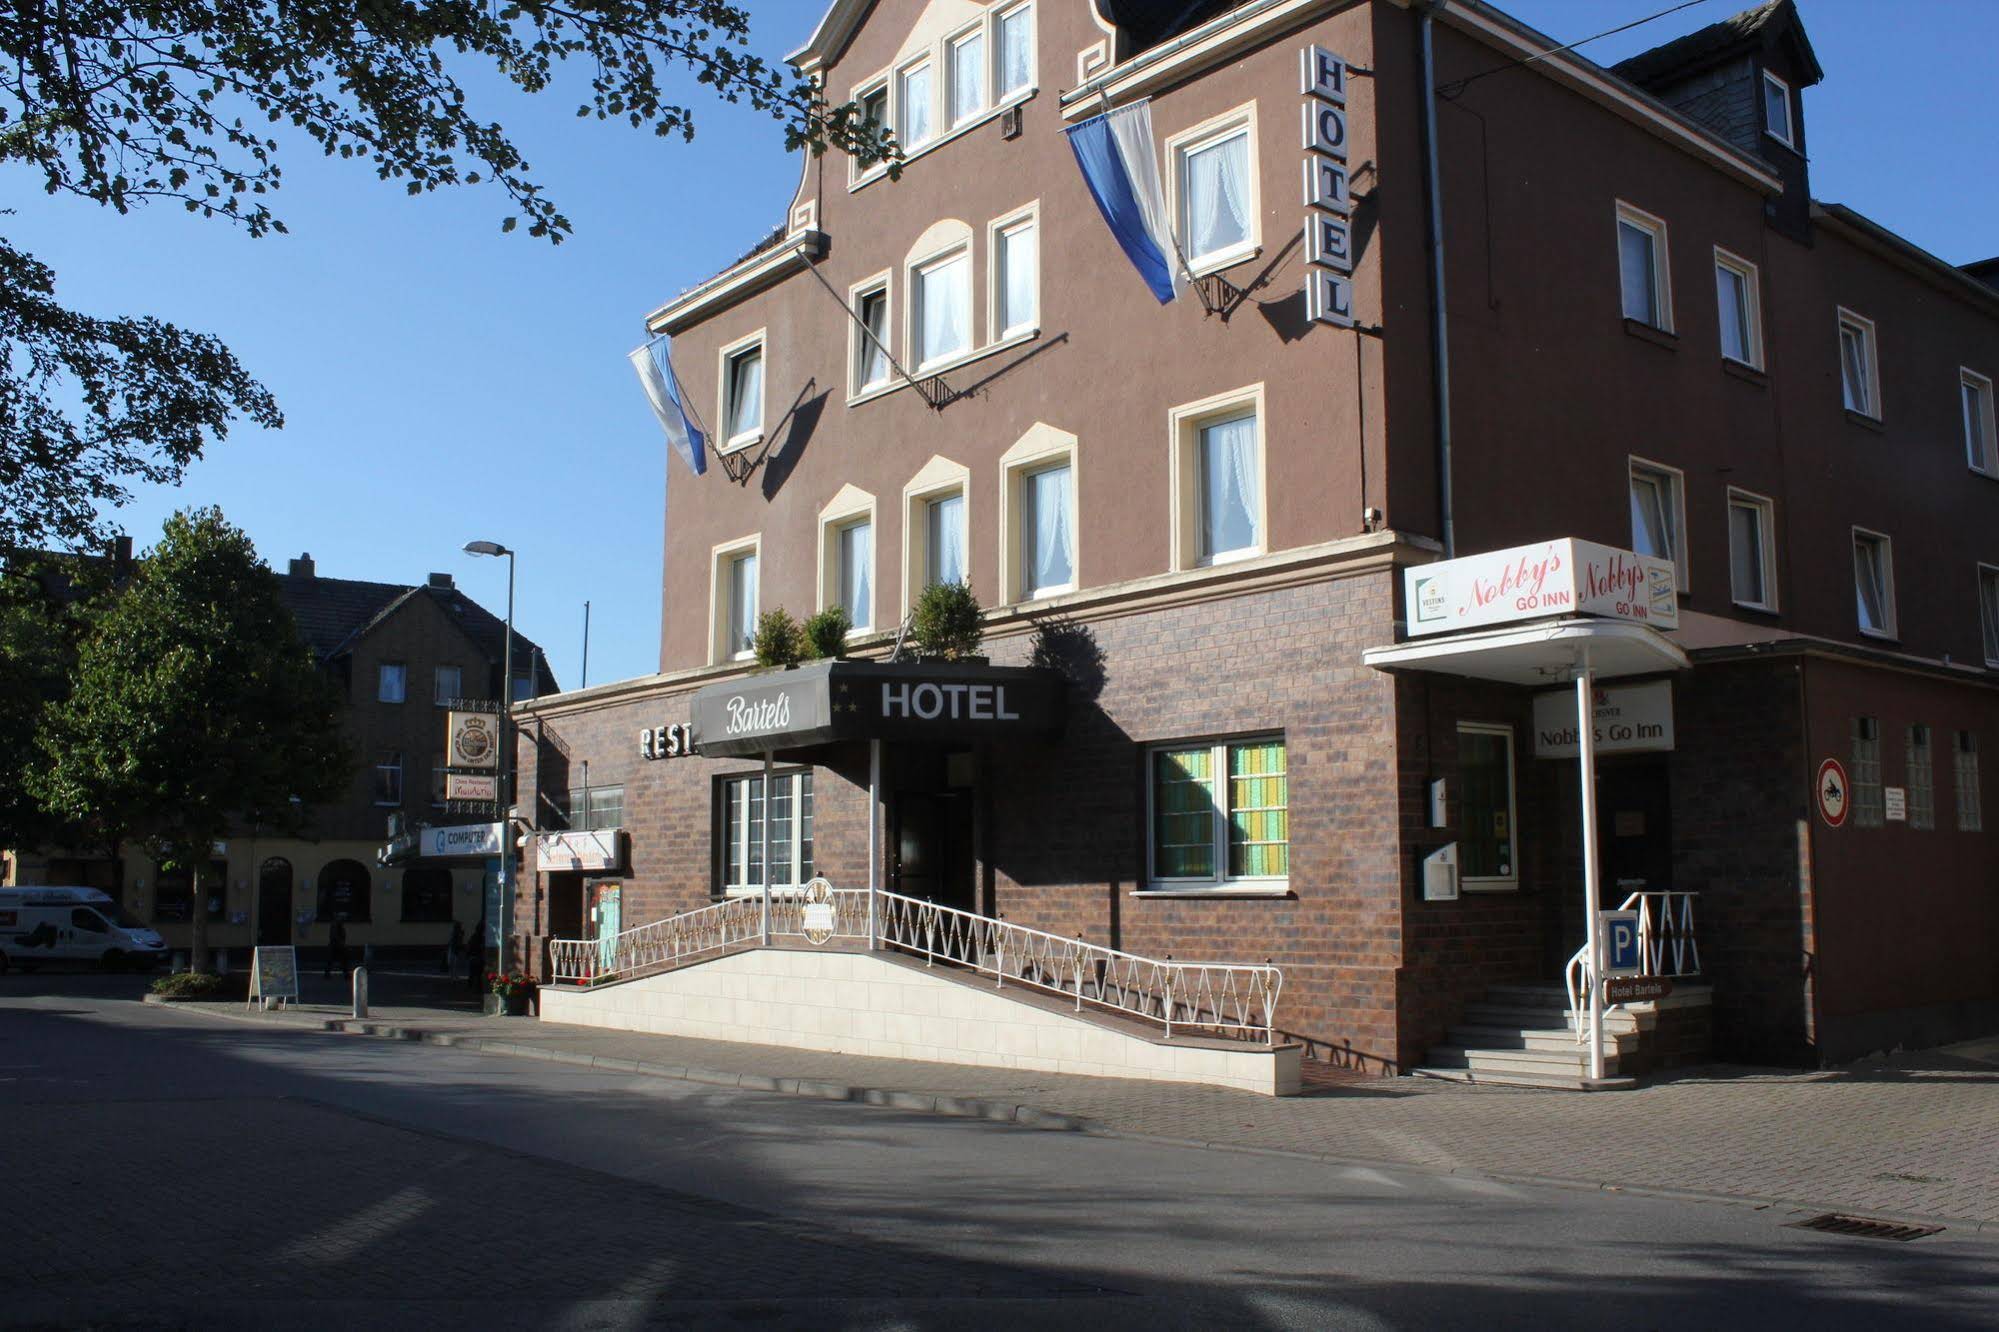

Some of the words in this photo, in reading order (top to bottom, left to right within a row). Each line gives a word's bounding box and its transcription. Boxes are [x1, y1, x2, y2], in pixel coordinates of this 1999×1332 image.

[1318, 54, 1349, 317] HOTEL
[1458, 544, 1561, 616] Nobby's
[1578, 553, 1644, 603] Nobby's
[1516, 595, 1538, 611] GO
[1542, 591, 1570, 607] INN
[1616, 601, 1630, 615] GO
[1632, 603, 1648, 619] INN
[726, 692, 790, 734] Bartels
[882, 682, 1020, 720] HOTEL
[640, 722, 698, 759] REST
[1609, 724, 1633, 741] Go
[1637, 723, 1663, 738] Inn
[448, 830, 486, 845] COMPUTER
[1614, 925, 1631, 963] P
[1611, 985, 1633, 998] Hotel
